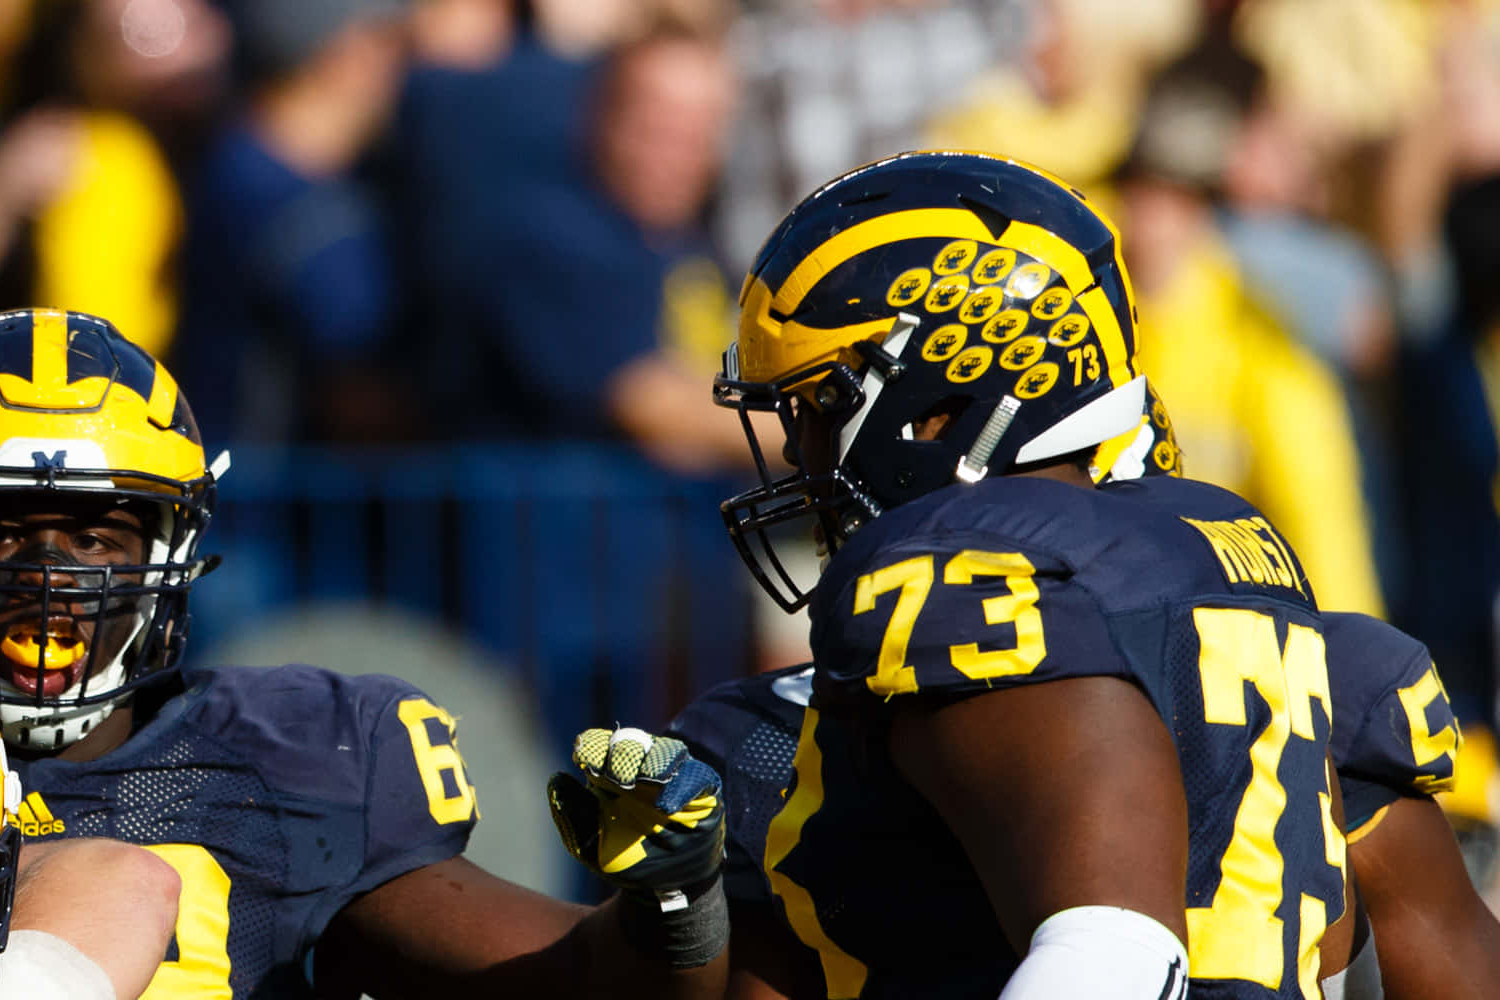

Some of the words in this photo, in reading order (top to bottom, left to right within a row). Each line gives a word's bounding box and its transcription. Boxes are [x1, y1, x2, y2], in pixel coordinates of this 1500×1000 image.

[1067, 344, 1100, 387] 73
[31, 449, 67, 469] M
[853, 549, 1047, 697] 73
